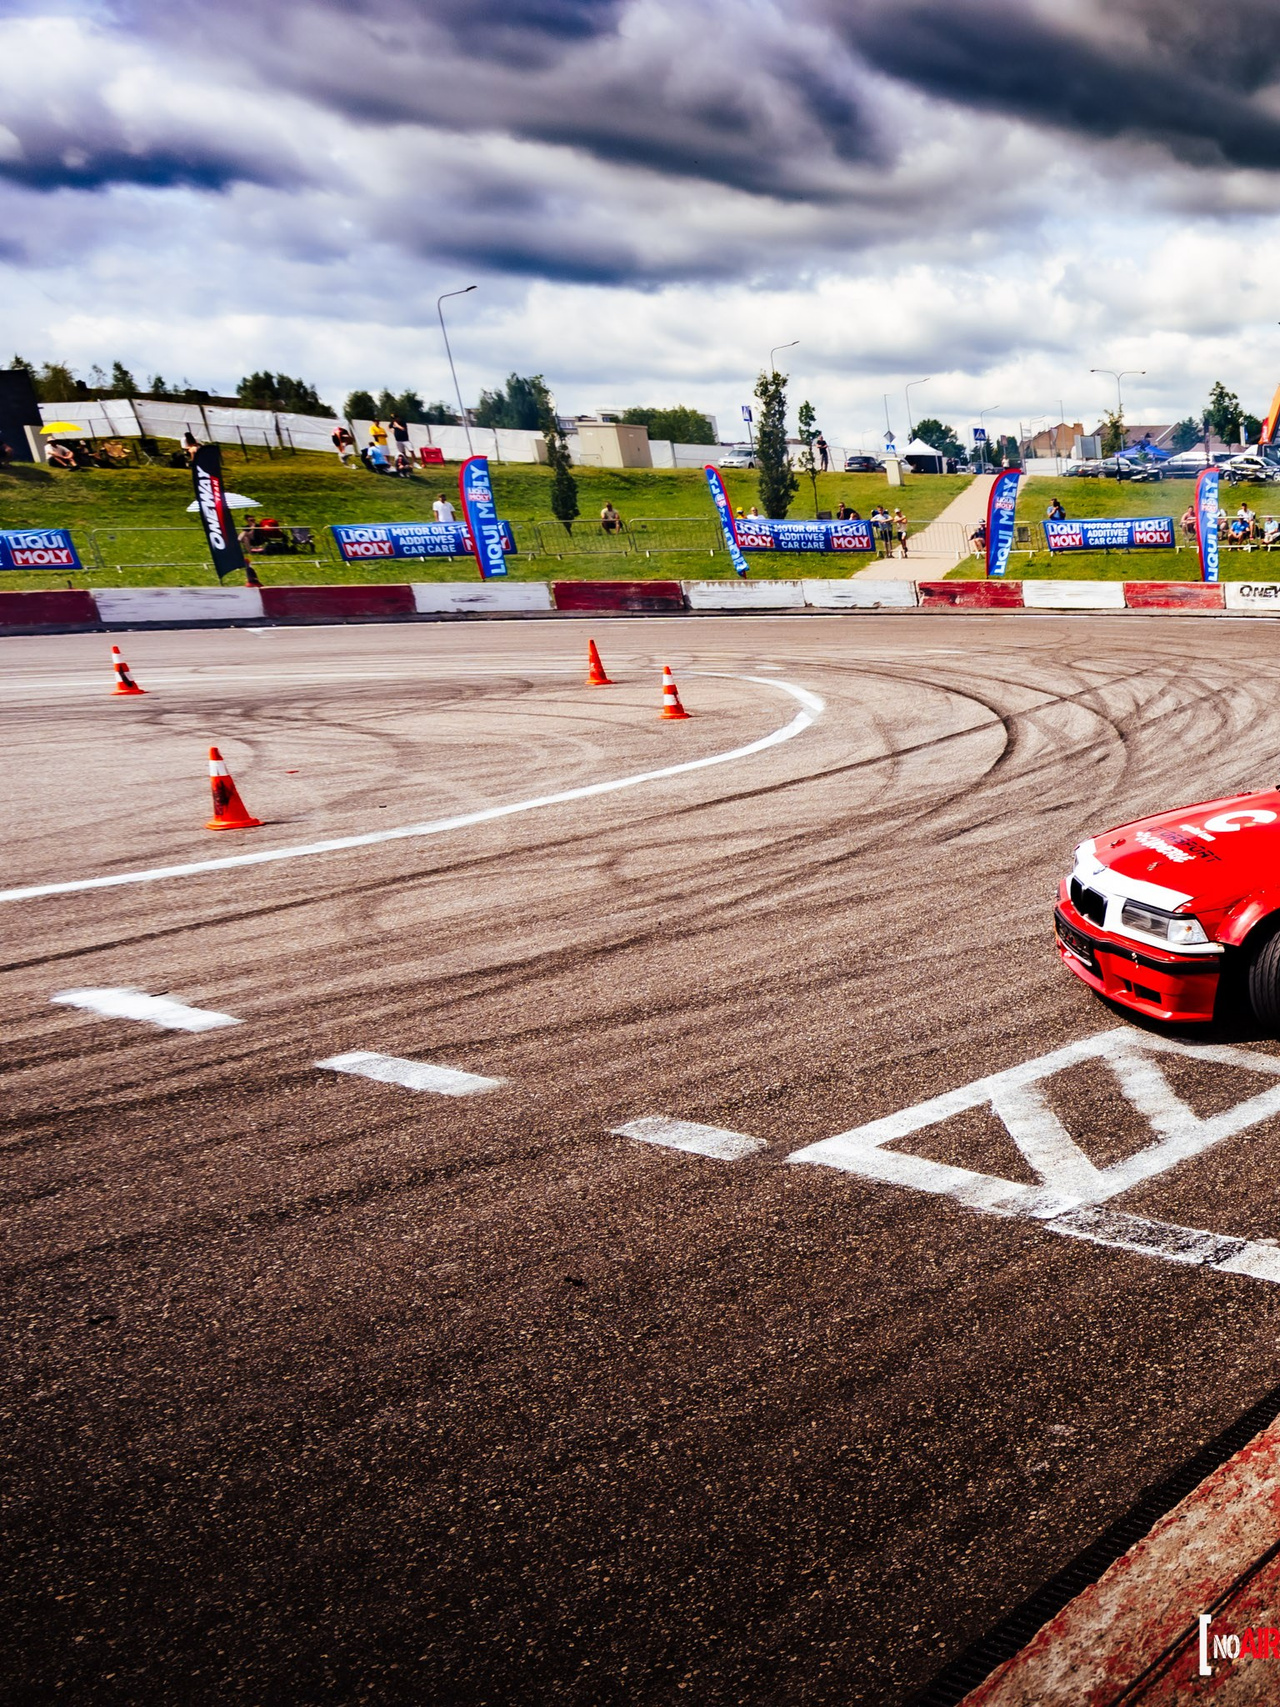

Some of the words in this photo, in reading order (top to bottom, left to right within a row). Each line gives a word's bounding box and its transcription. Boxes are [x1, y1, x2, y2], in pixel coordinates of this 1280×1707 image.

[197, 465, 226, 550] ONEWAY
[392, 527, 430, 536] MOTOR
[432, 526, 457, 535] OILS
[831, 525, 866, 536] LIQUI
[1048, 523, 1080, 535] LIQUI
[1135, 521, 1169, 532] LIQUI
[340, 529, 388, 543] LIQUI
[779, 533, 824, 541] ADDITIVES
[1087, 529, 1129, 537] ADDITIVES
[1136, 532, 1170, 544] MOLY
[8, 535, 65, 549] LIQUI
[400, 535, 455, 545] ADDITIVES
[737, 535, 773, 547] MOLY
[782, 541, 800, 549] CAR
[801, 541, 825, 549] CARE
[833, 537, 869, 549] MOLY
[1050, 535, 1082, 547] MOLY
[1089, 537, 1107, 545] CAR
[345, 543, 393, 557] MOLY
[403, 545, 425, 554] CAR
[428, 544, 456, 553] CARE
[481, 524, 506, 574] LIQUI
[994, 530, 1013, 574] LIQUI
[14, 550, 69, 564] MOLY
[1207, 533, 1218, 582] LIQUI
